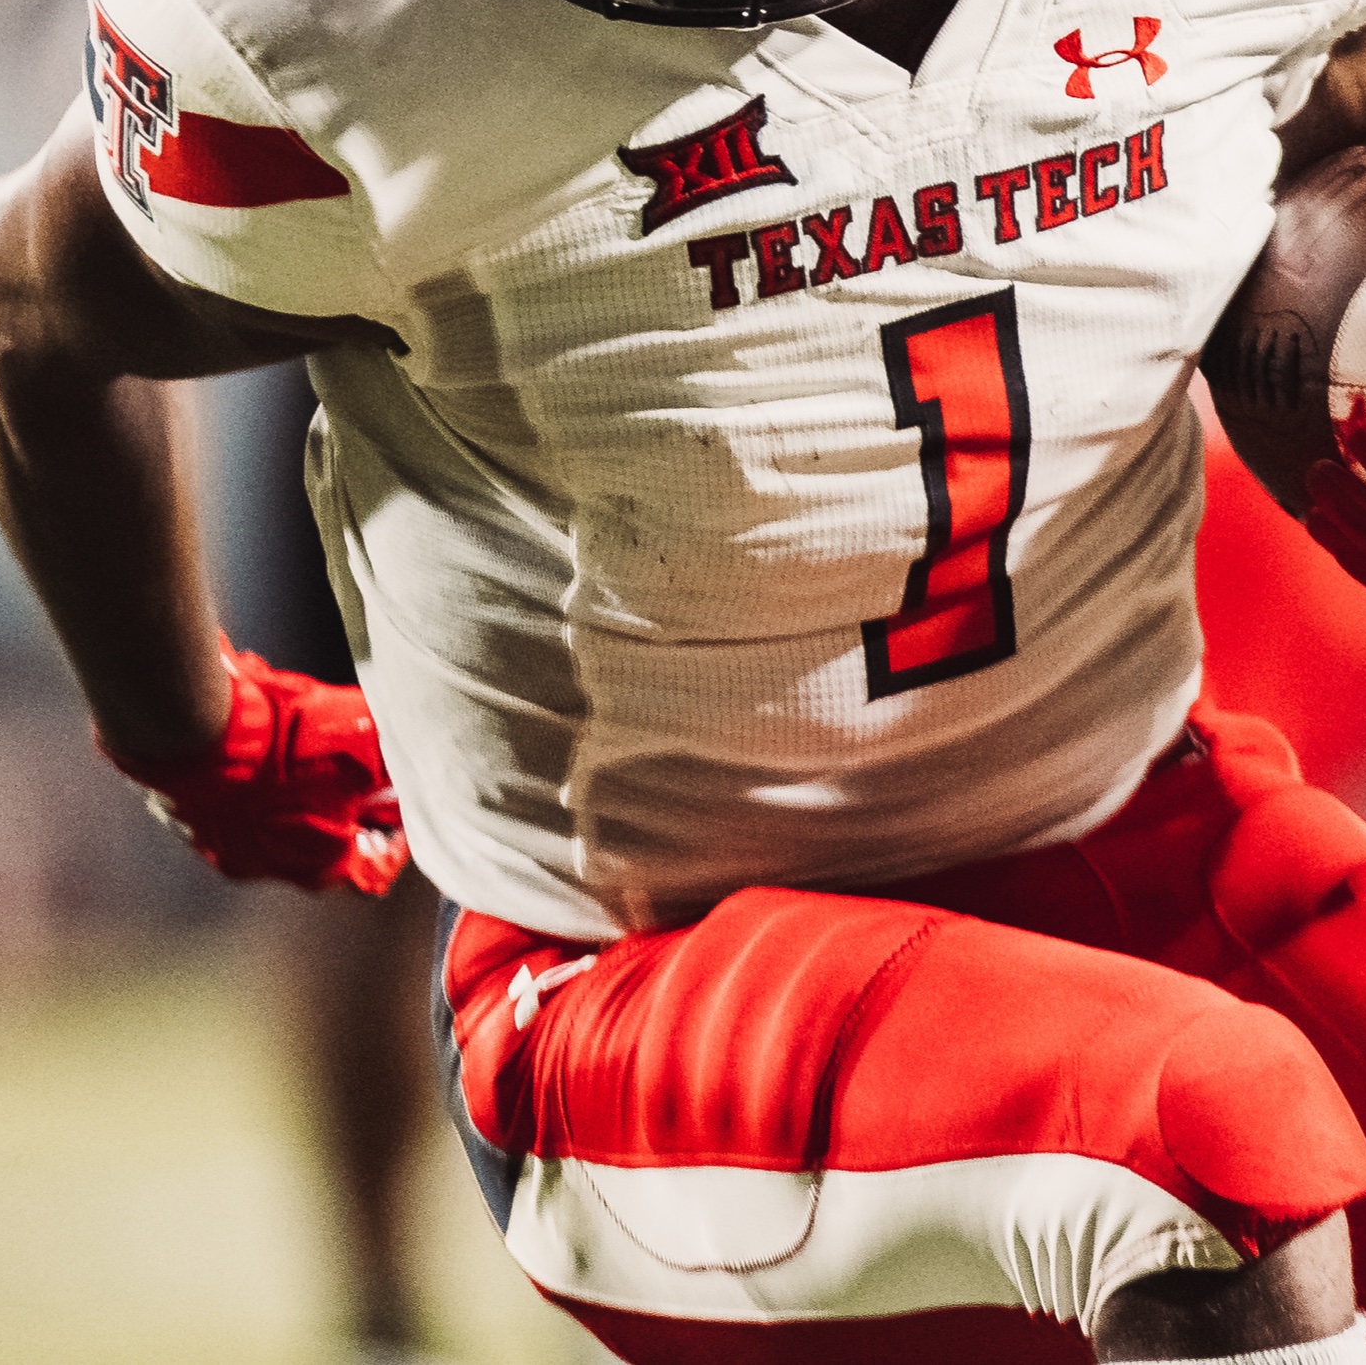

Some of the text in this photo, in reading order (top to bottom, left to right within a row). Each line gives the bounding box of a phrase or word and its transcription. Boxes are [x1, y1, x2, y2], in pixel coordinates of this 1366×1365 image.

[687, 119, 1169, 311] TEXAS TECH
[860, 284, 1033, 702] 1
